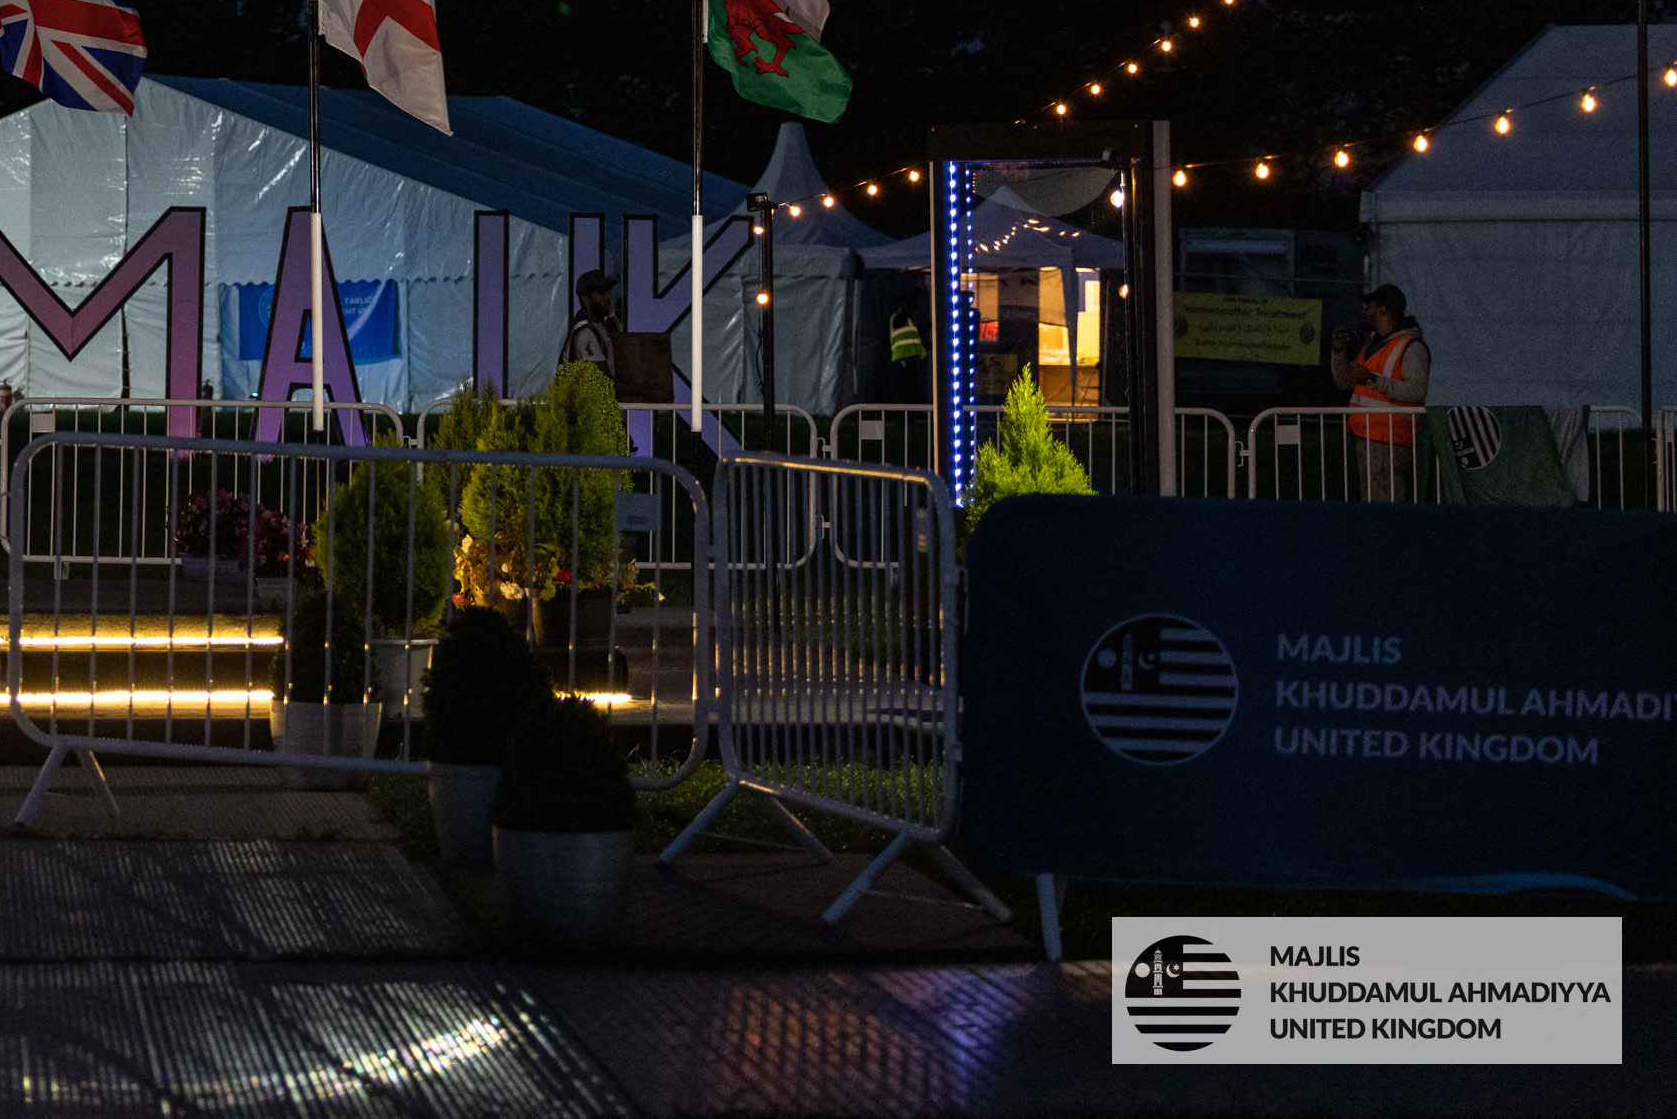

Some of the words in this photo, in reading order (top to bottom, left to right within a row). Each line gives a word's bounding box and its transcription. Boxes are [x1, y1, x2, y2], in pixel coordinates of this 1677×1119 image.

[1276, 633, 1403, 665] MAJLIS
[1275, 681, 1515, 716] KHUDDAMUL
[1522, 687, 1677, 723] AHMADI
[1274, 726, 1410, 759] UNITED
[1418, 732, 1599, 766] KINGDOM
